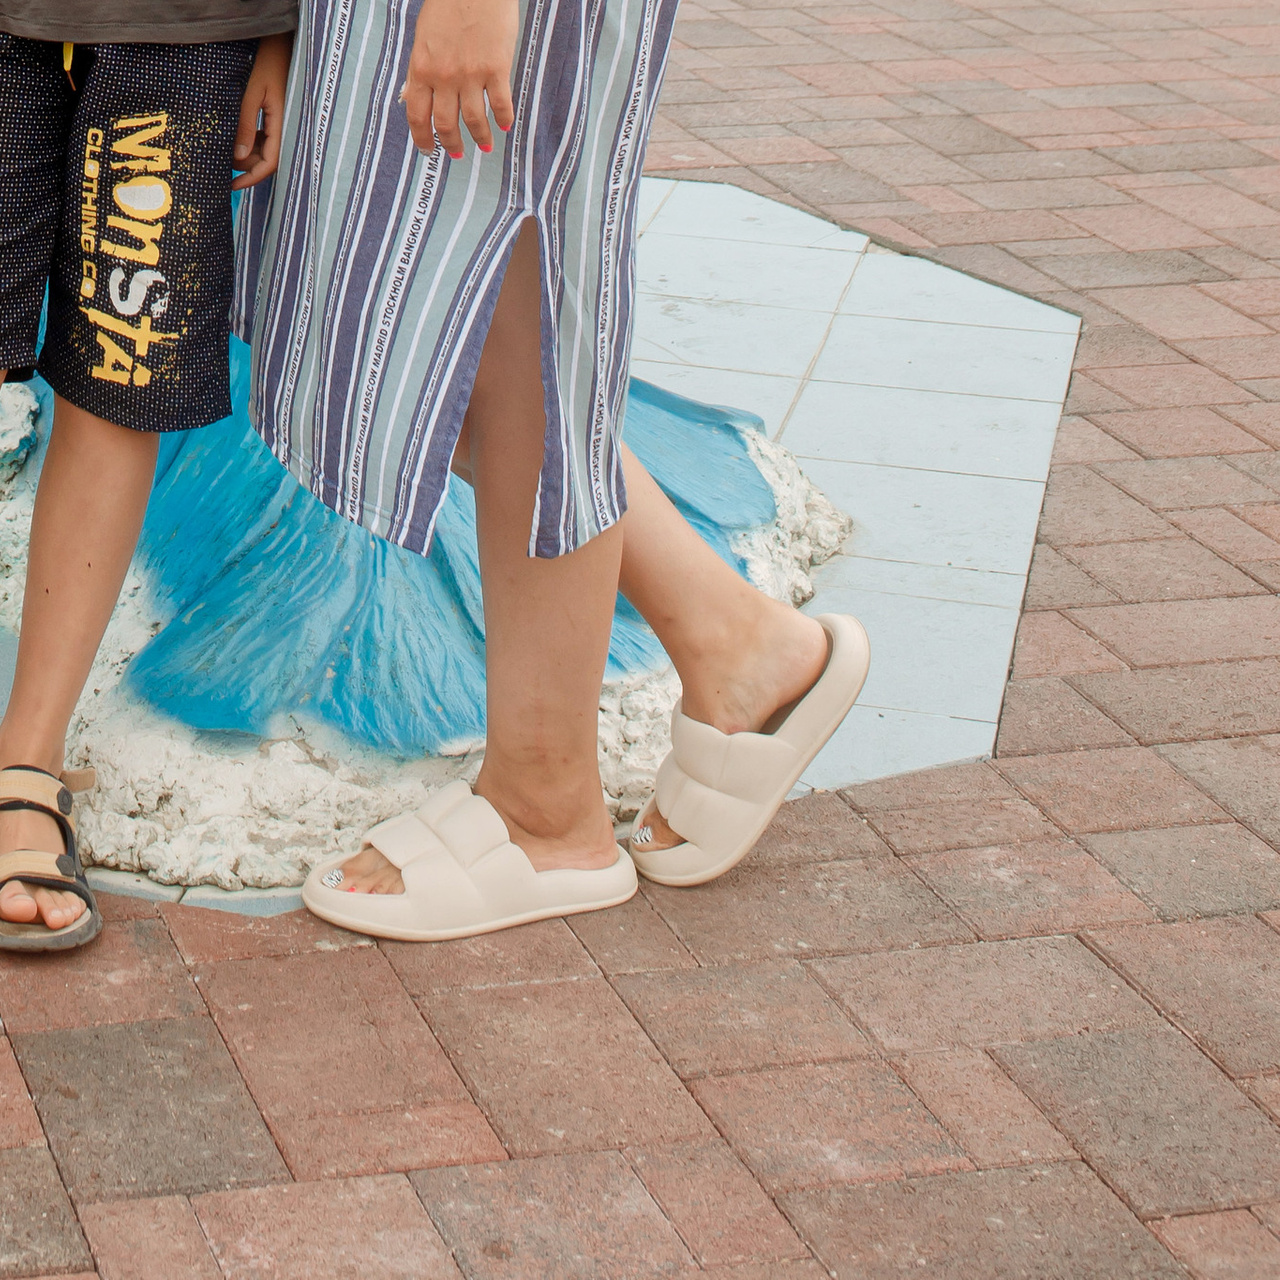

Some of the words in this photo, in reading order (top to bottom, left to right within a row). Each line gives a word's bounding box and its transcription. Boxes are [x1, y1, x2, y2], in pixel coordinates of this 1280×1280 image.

[333, 12, 347, 50] MADRID
[321, 52, 339, 115] STOCKHOLM
[315, 114, 327, 160] BANGKOK
[621, 90, 641, 141] BANGKOK
[612, 142, 628, 186] LONDON
[80, 127, 104, 254] CLOTHING
[416, 173, 436, 215] LONDON
[606, 187, 620, 226] MADRID
[400, 216, 424, 265] BANGKOK
[603, 227, 613, 288] AMSTERDAM
[382, 266, 407, 327] STOCKHOLM
[296, 303, 310, 348] MOSCOW
[372, 328, 388, 368] MADRID
[288, 349, 301, 385] MADRID
[363, 369, 378, 414] MOSCOW
[352, 416, 369, 476] AMSTERDAM
[592, 437, 602, 487] BANGKOK
[349, 475, 359, 515] MADRID
[594, 486, 610, 528] LONDON
